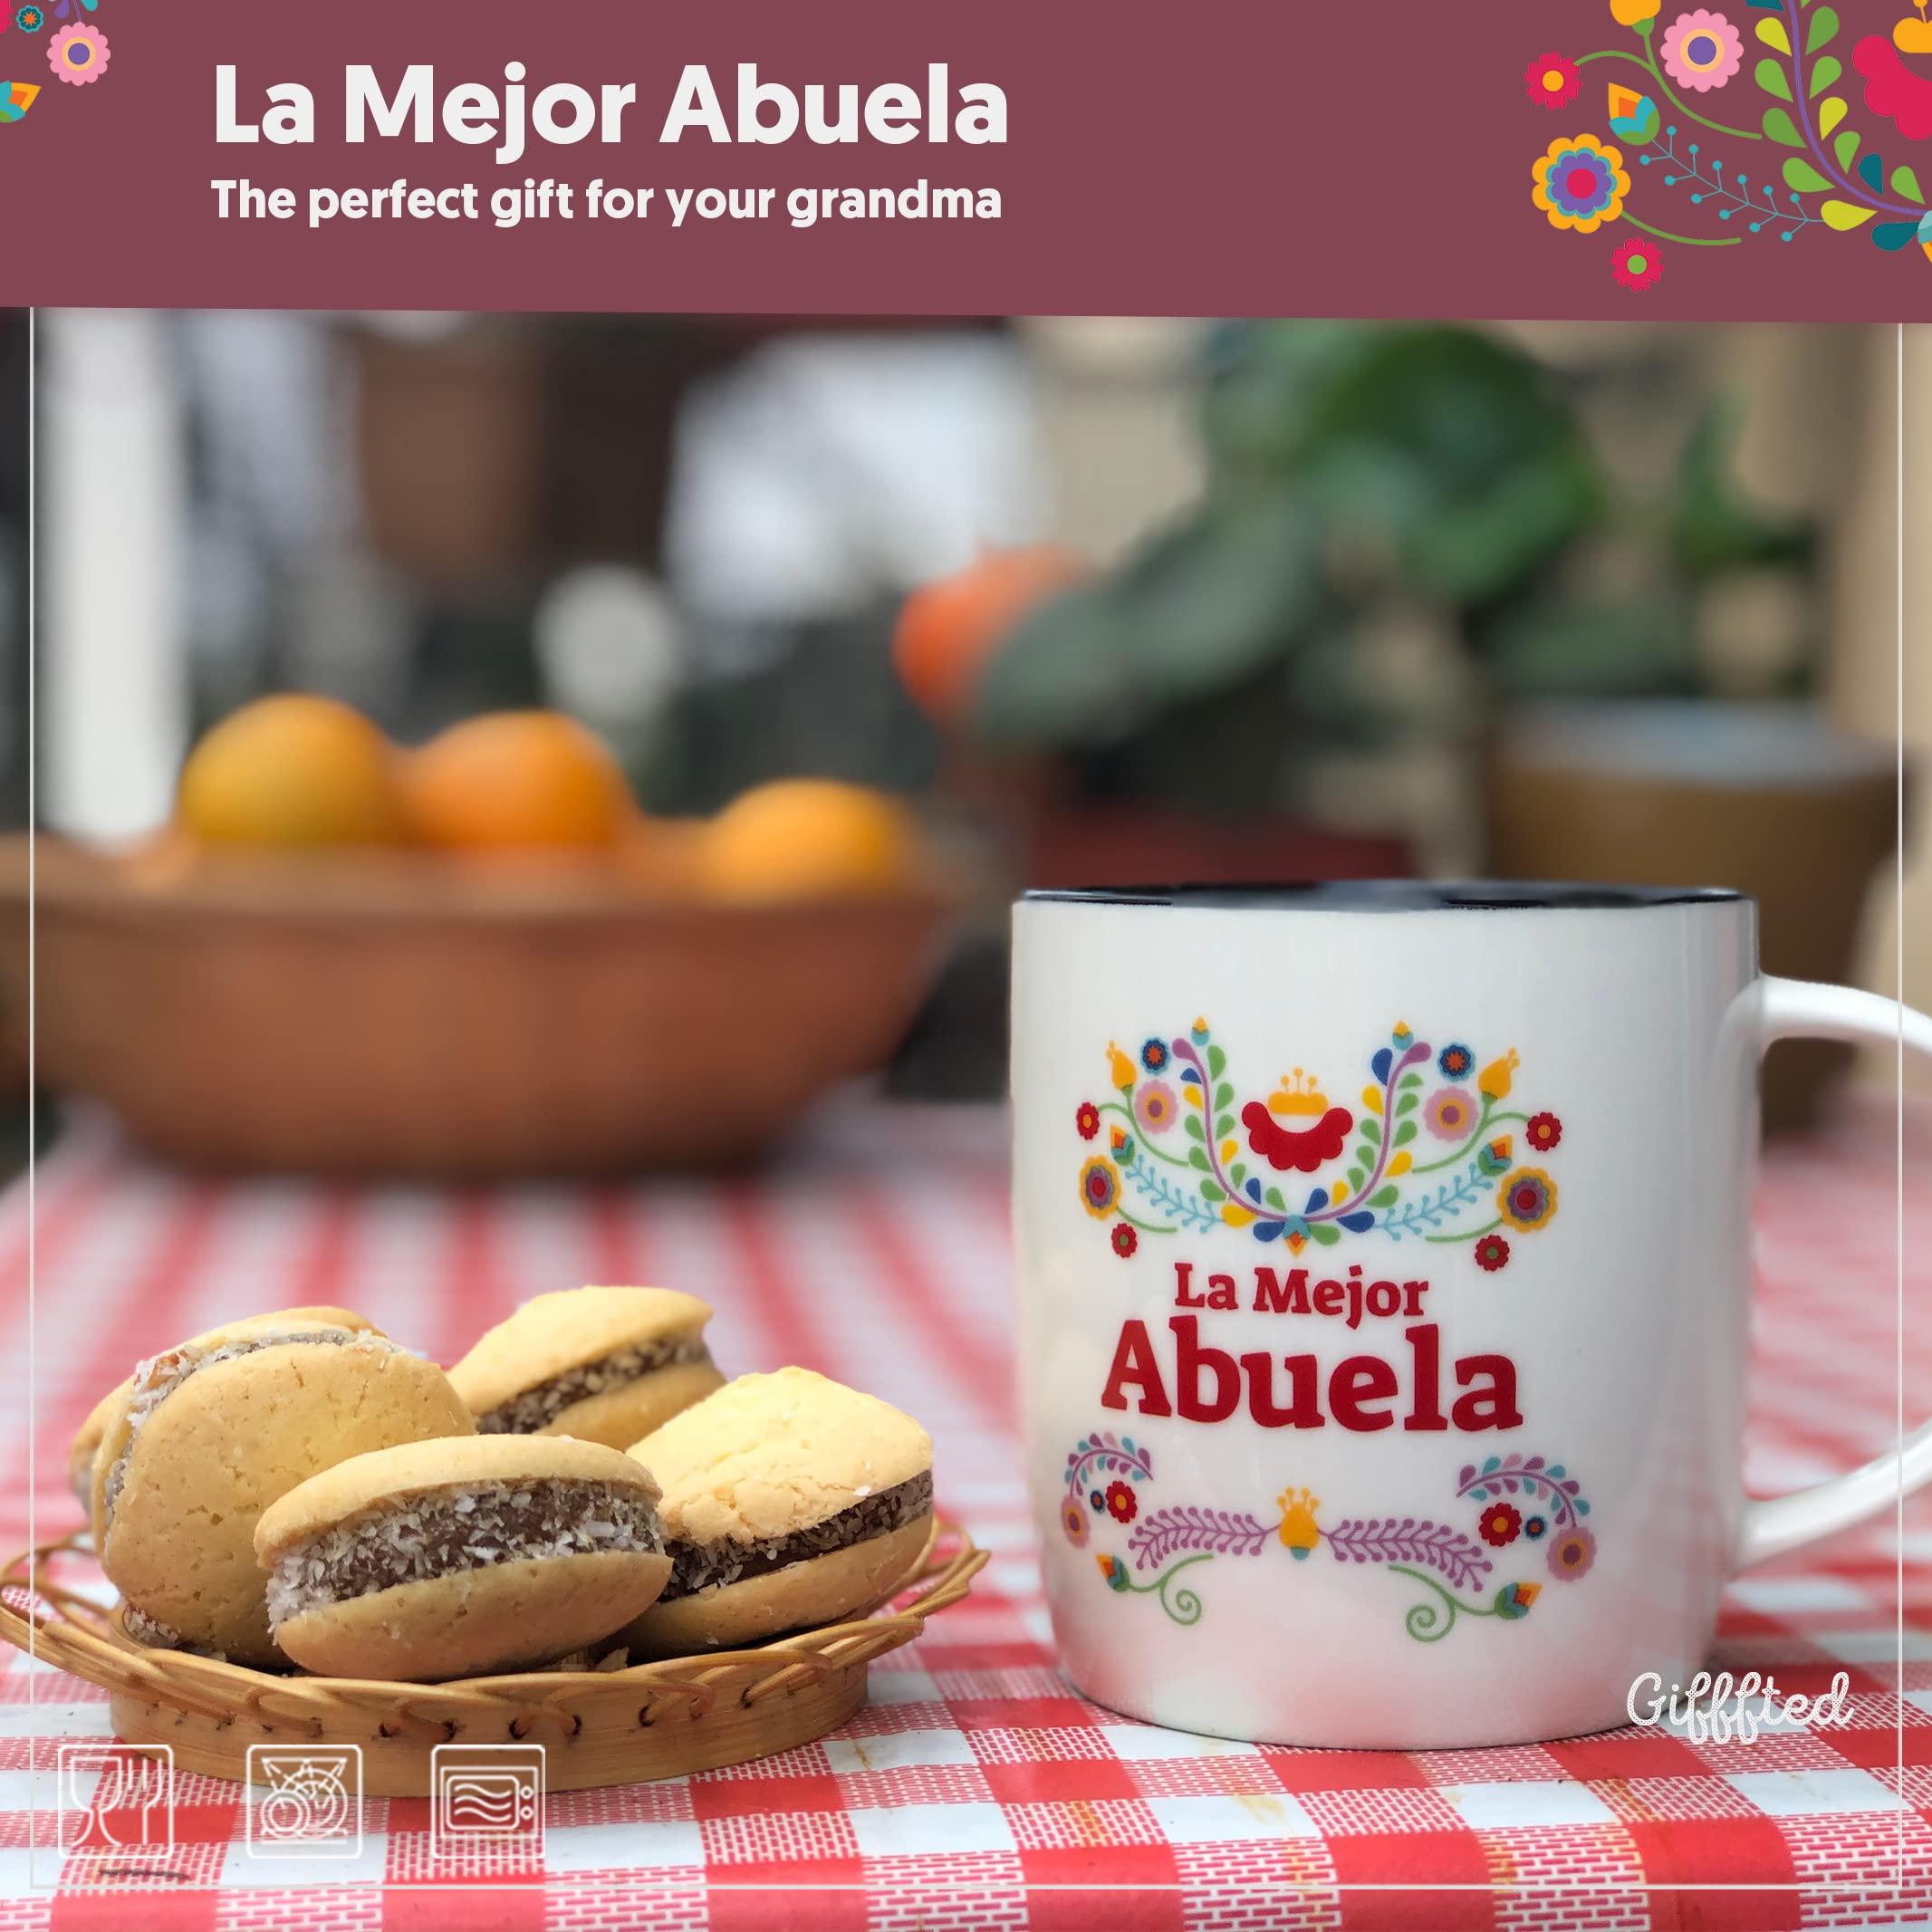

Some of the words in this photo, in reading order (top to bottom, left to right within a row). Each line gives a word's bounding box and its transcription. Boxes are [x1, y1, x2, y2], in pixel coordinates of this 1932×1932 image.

[1174, 1262, 1239, 1311] La
[1252, 1264, 1430, 1330] Mejor
[1101, 1314, 1523, 1433] Abuela
